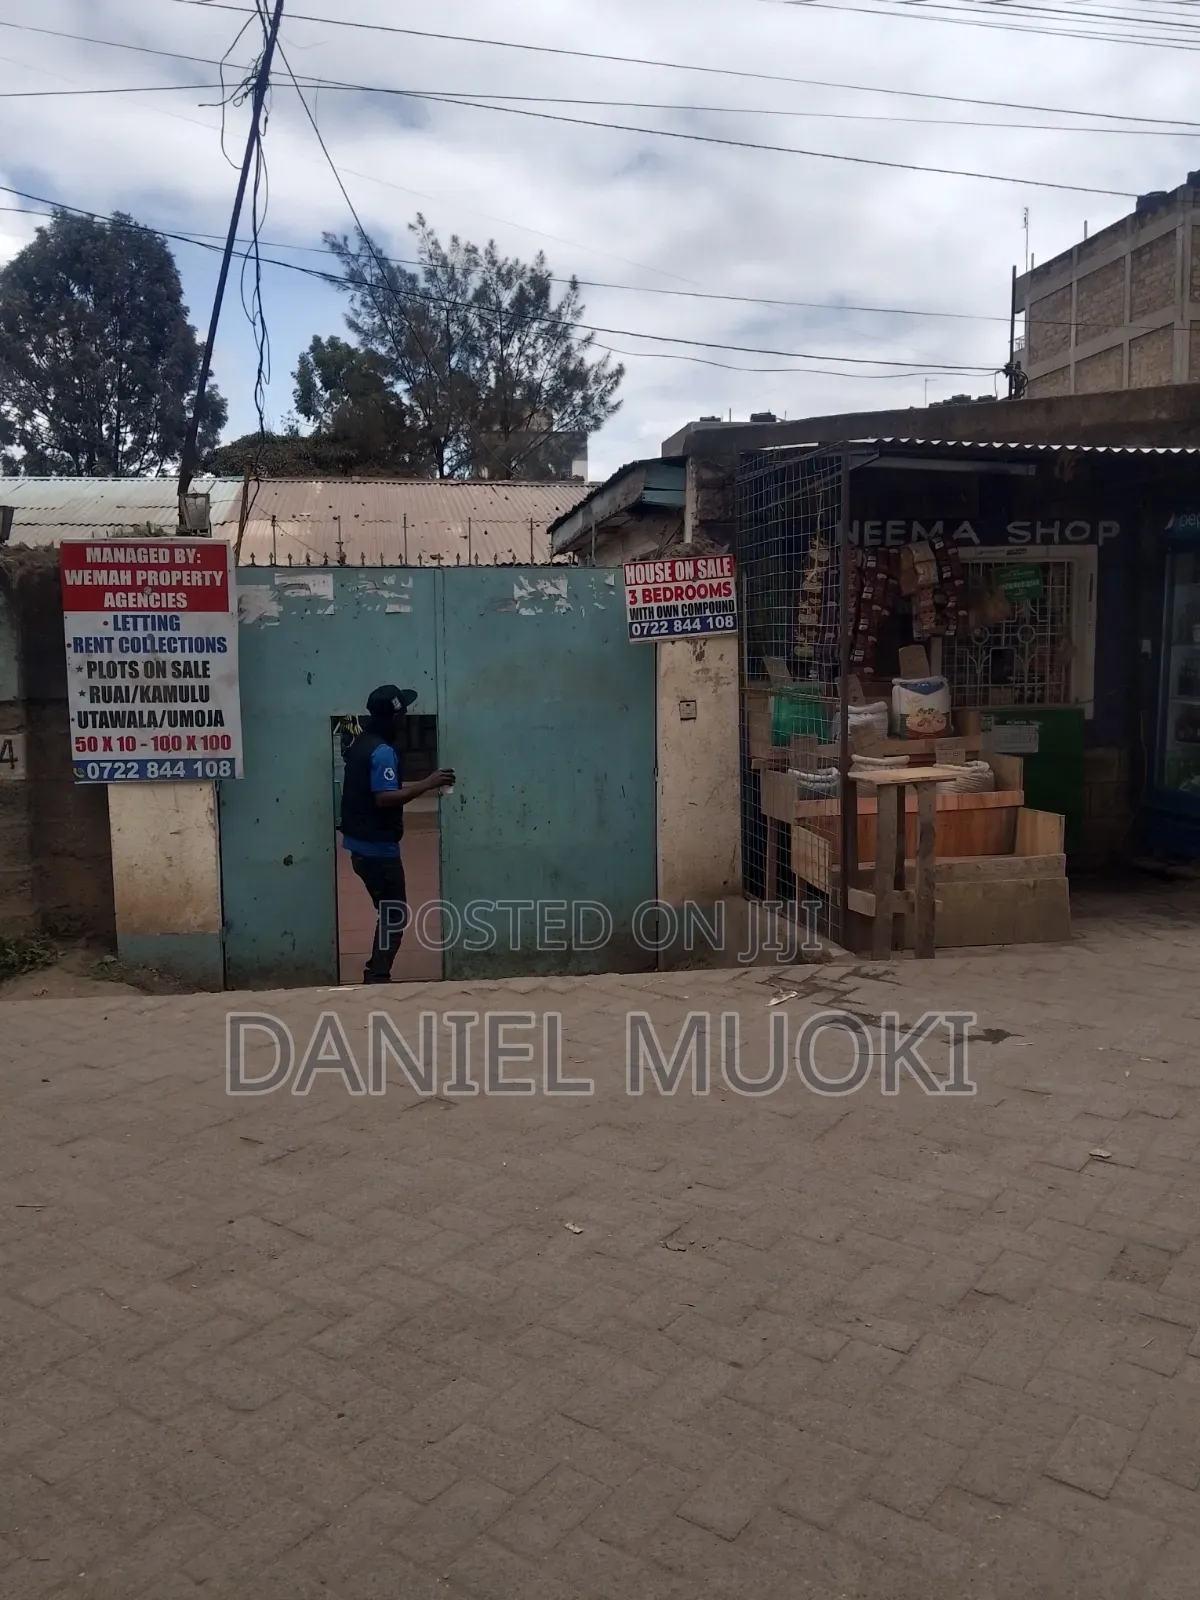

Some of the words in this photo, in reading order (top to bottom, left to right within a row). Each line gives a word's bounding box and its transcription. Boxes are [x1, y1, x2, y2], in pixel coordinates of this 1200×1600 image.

[837, 519, 981, 547] NEEMA
[1006, 519, 1121, 547] SHOP
[85, 547, 170, 564] MANAGED
[174, 548, 201, 564] BY:
[64, 569, 132, 586] WEMAH
[136, 570, 224, 587] PROPERTY
[624, 562, 673, 585] HOUSE
[674, 560, 695, 581] ON
[696, 557, 732, 579] SALE
[103, 591, 188, 609] AGENCIES
[628, 589, 638, 605] 3
[641, 581, 733, 605] BEDROOMS
[629, 605, 655, 621] WITH
[656, 604, 679, 619] OWN
[681, 599, 736, 617] COMPOUND
[112, 614, 181, 632] LETTING
[631, 621, 669, 636] 0722
[673, 617, 701, 632] 844
[706, 615, 734, 630] 108
[72, 636, 114, 654] RENT
[118, 635, 228, 654] COLLECTIONS
[87, 660, 140, 679] PLOTS
[143, 660, 167, 679] ON
[170, 660, 211, 679] SALE
[89, 685, 210, 704] RUAI/KAMULU
[77, 709, 225, 729] UTAWALA/UMOJA
[75, 735, 100, 752] 50
[102, 736, 114, 752] X
[116, 735, 137, 752] 10
[150, 734, 182, 752] 100
[186, 735, 198, 751] X
[200, 734, 232, 751] 100
[86, 761, 140, 780] 0722
[146, 761, 186, 779] 844
[193, 760, 232, 778] 108
